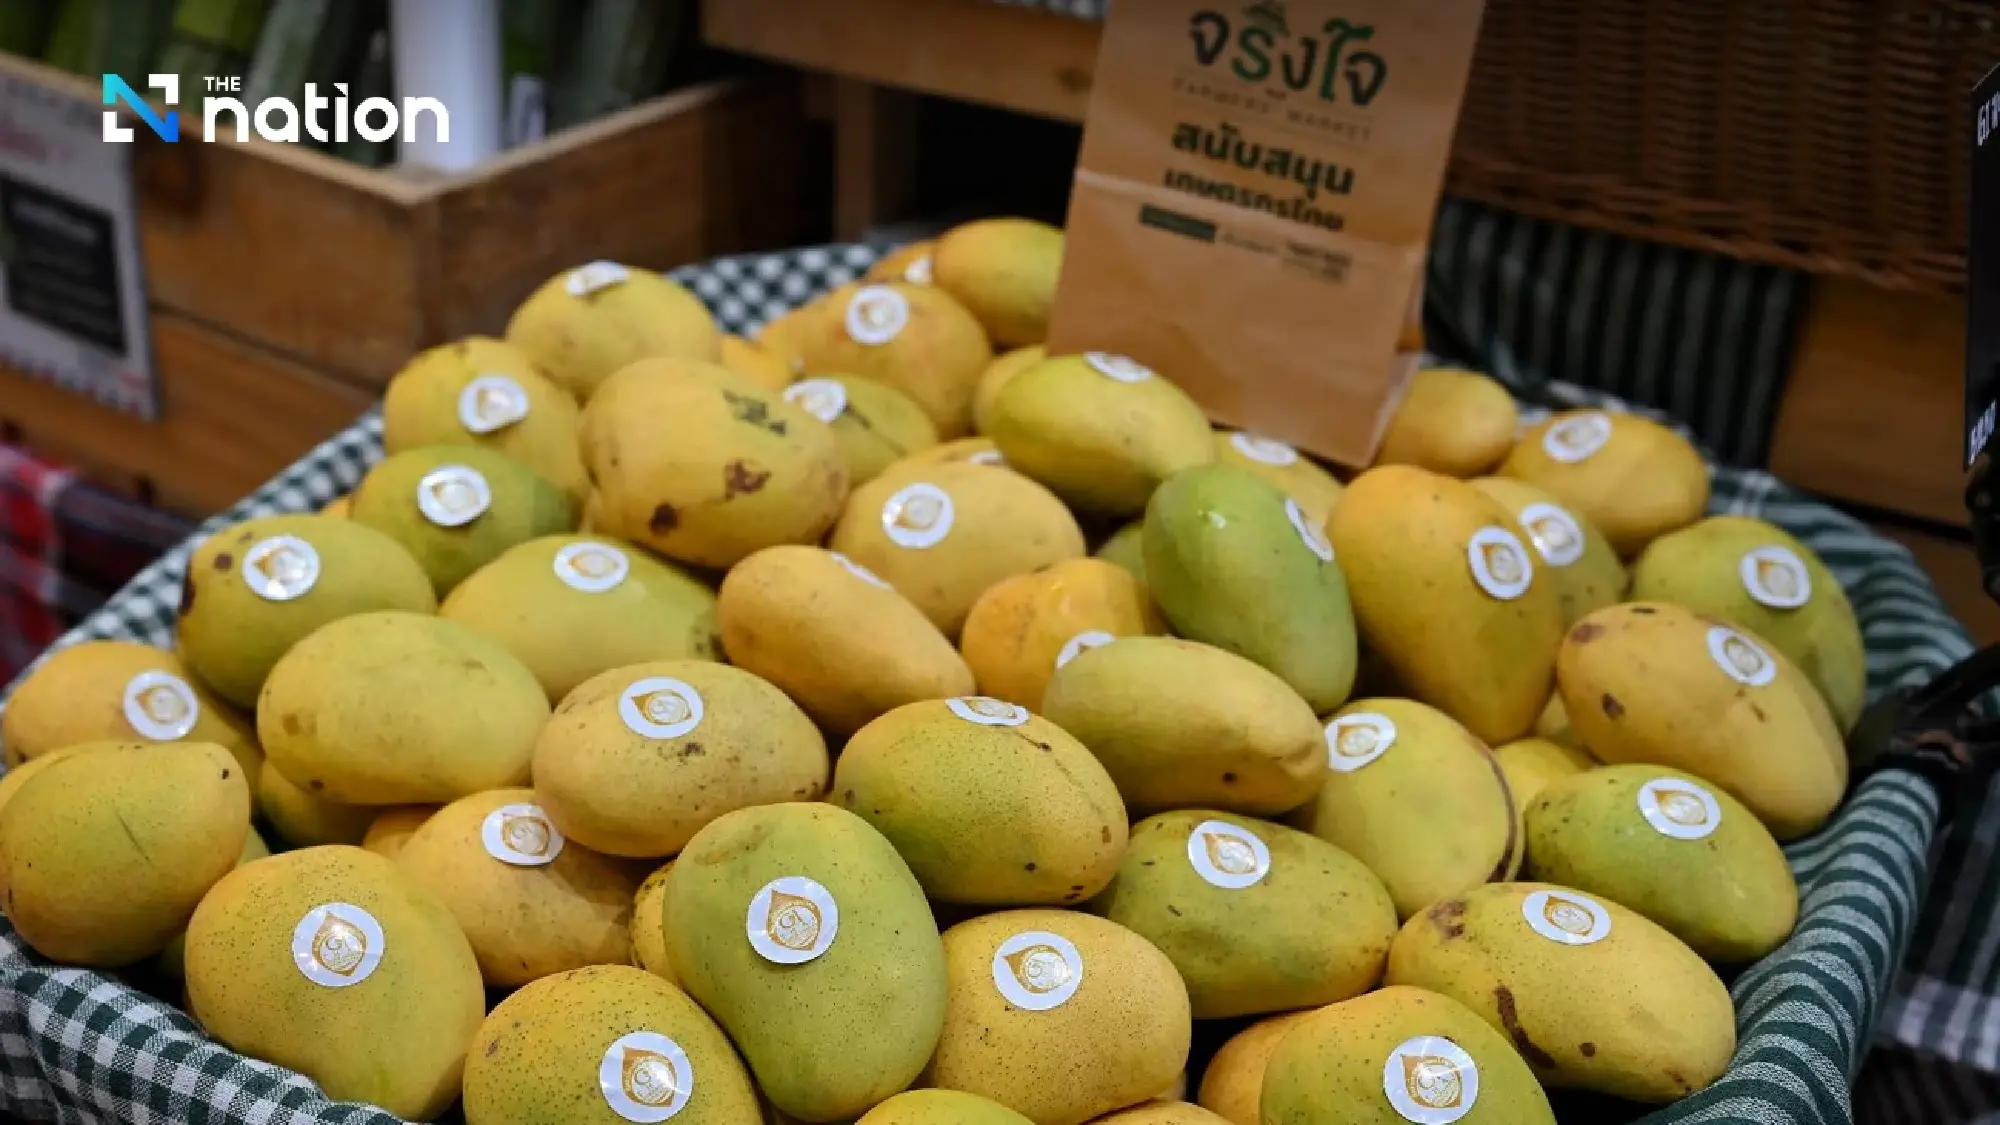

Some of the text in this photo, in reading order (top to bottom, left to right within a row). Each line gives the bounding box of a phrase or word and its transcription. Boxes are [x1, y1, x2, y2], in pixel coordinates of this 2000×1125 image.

[1188, 2, 1388, 107] จริงใจ
[1171, 121, 1356, 201] สนับสนุน
